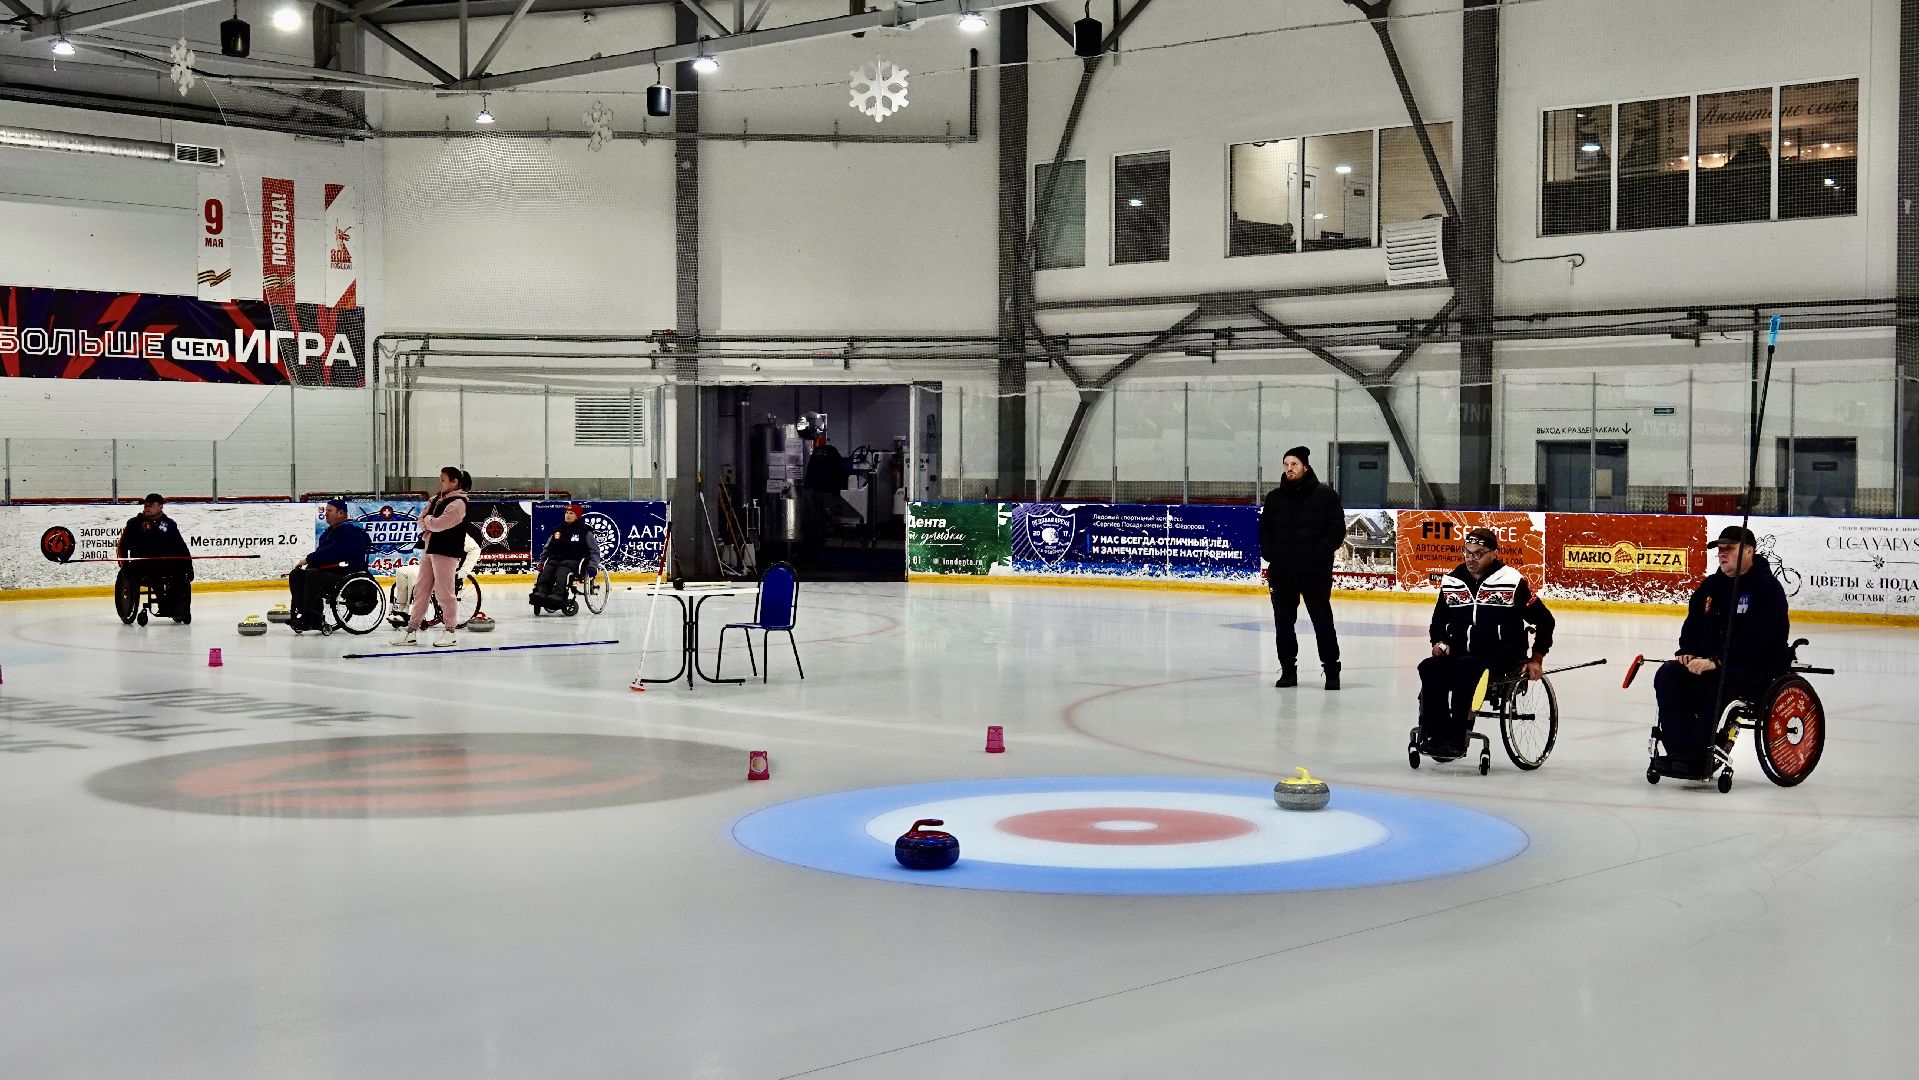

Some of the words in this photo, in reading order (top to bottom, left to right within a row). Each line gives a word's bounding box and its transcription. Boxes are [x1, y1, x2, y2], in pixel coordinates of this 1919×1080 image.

[204, 198, 223, 235] 9
[271, 192, 290, 265] ПОБЕДА!
[205, 237, 223, 248] МАЯ
[0, 326, 164, 358] БОЛЬШЕ
[175, 340, 225, 359] ЧЕМ
[235, 328, 357, 367] ИГРА
[1536, 427, 1561, 435] ВЫХОД
[1567, 426, 1620, 435] РАЗДЕАЛКАМ
[364, 522, 418, 531] ЕМОНТ
[190, 536, 274, 549] Металлургия
[278, 534, 298, 546] 2.0
[1092, 535, 1099, 544] У
[1100, 535, 1120, 544] НАС
[1120, 536, 1156, 546] ВСЕГДА
[1157, 536, 1209, 547] ОТЛИЧНЫЙ
[1209, 537, 1230, 548] ЛЁД
[1826, 536, 1869, 551] OLGA
[80, 550, 108, 560] ЗАВОД
[1092, 546, 1100, 554] И
[1100, 547, 1179, 557] ЗАМЕЧАТЕЛЬНОЕ
[1180, 549, 1243, 559] НАСТРОЕНИЕ!
[1415, 554, 1461, 563] АВТОЗАПЧАСТИ
[1568, 550, 1612, 564] MARIO
[1636, 553, 1682, 566] PIZZA
[1810, 575, 1859, 588] ЦВЕТЫ
[1865, 579, 1875, 589] &
[1841, 593, 1885, 602] ДОСТАВК
[1896, 594, 1916, 603] 24/7
